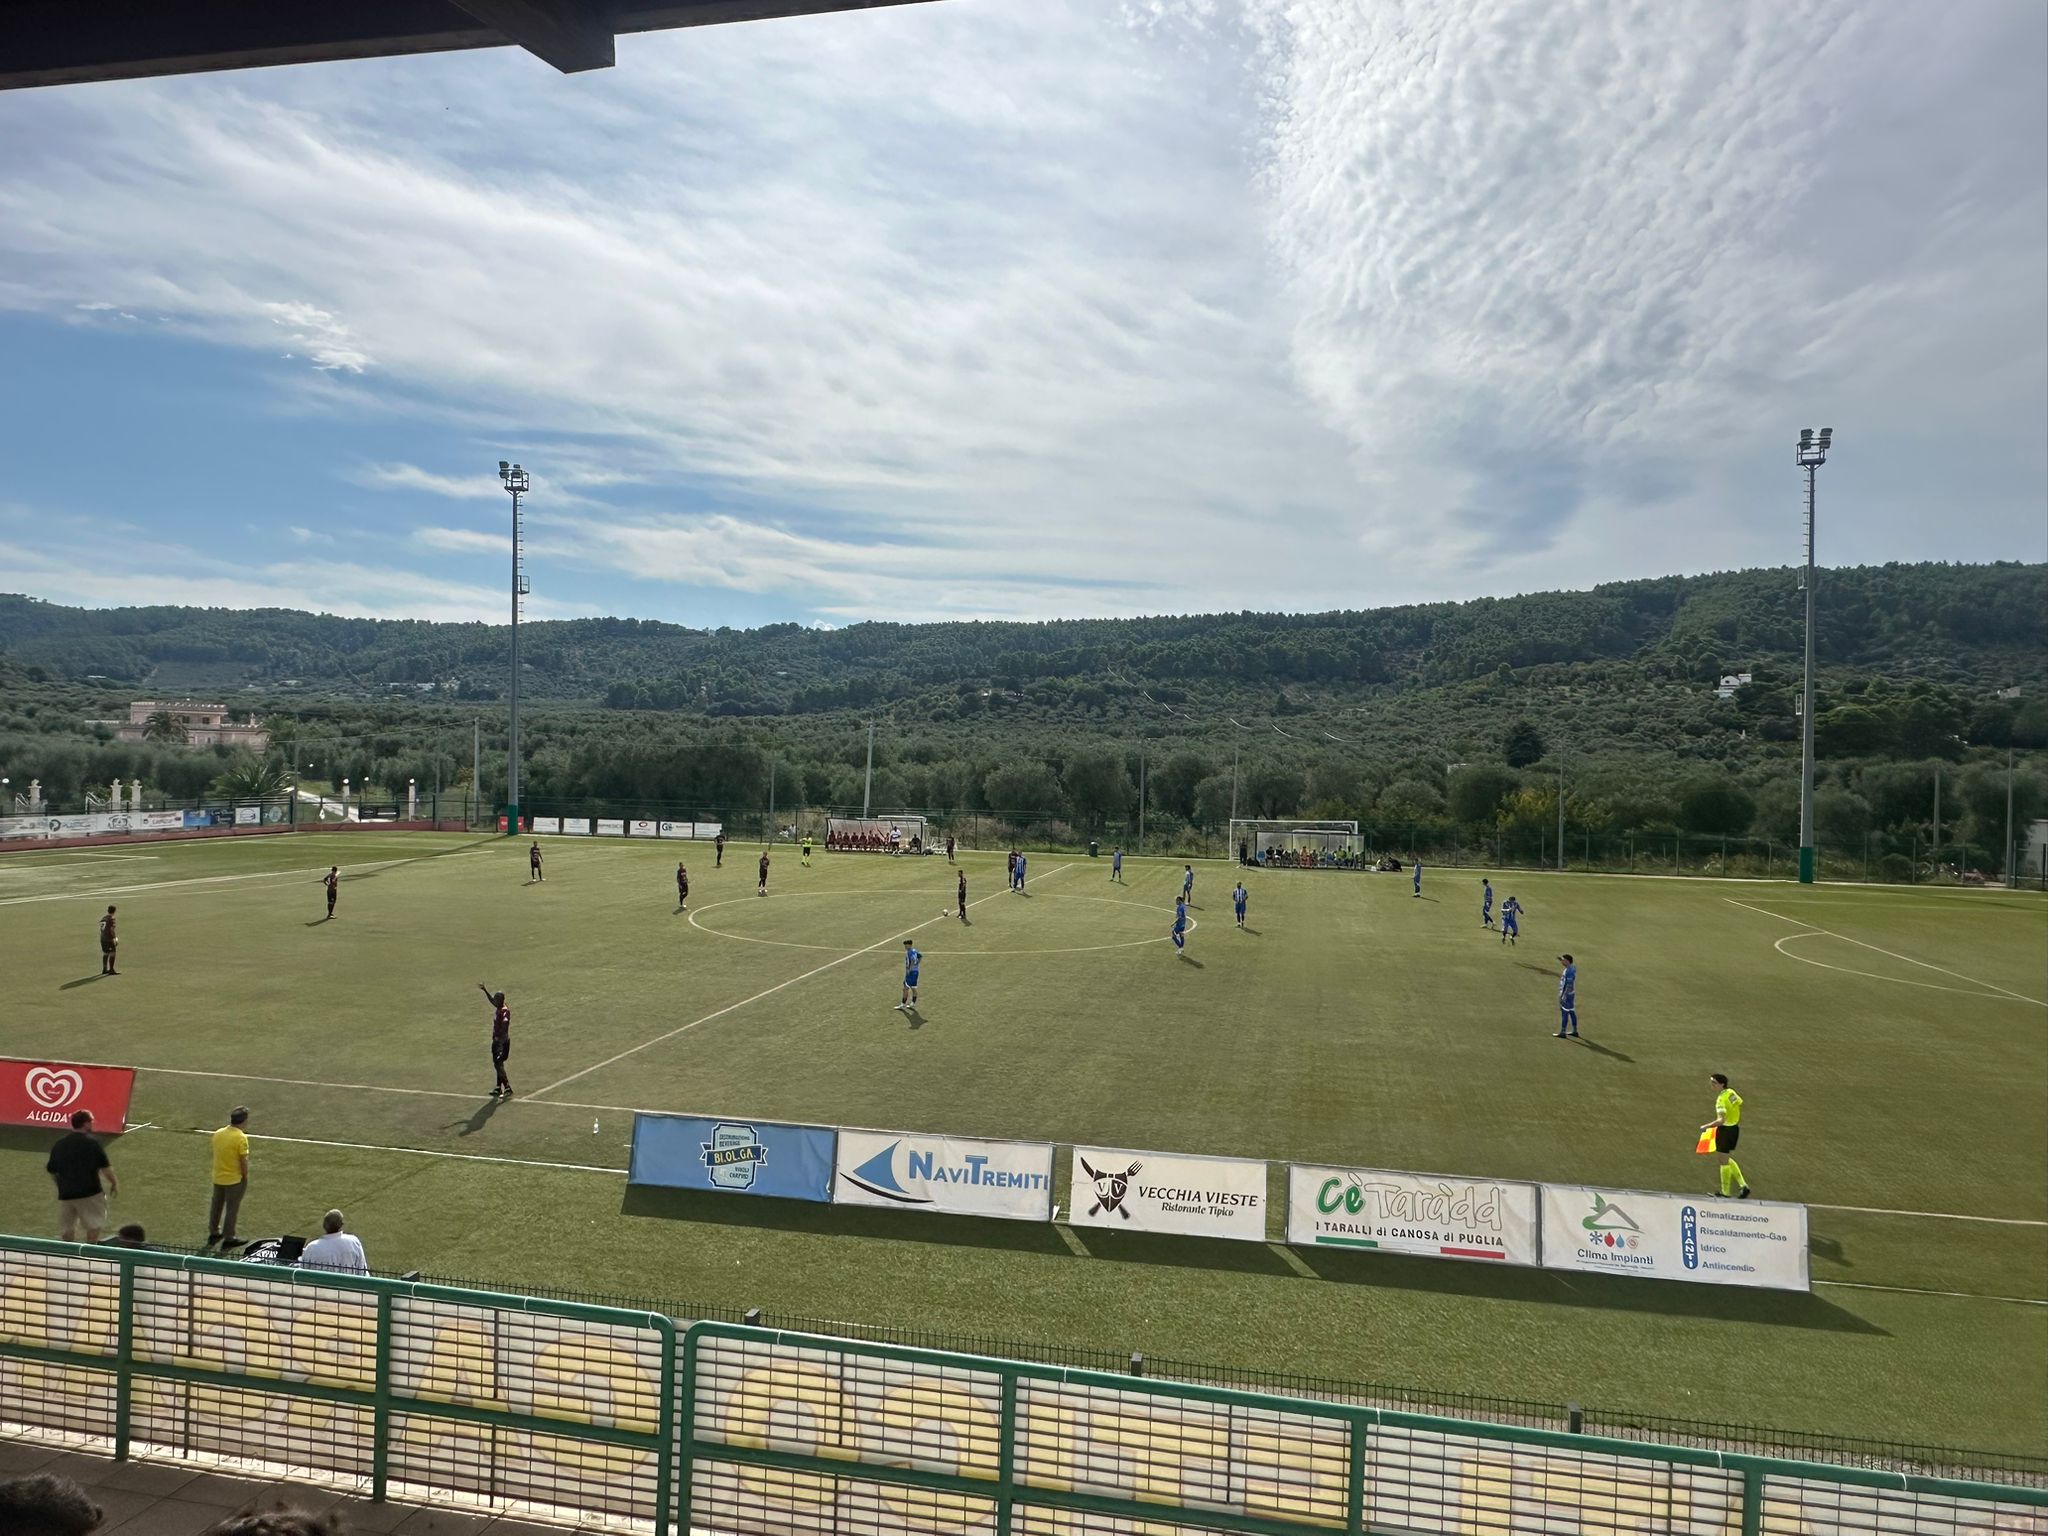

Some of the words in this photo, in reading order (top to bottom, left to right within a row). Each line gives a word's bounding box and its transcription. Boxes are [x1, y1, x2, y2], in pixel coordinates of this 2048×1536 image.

[26, 1111, 68, 1123] ALGIDA
[1138, 1186, 1201, 1203] VECCHIA
[1205, 1191, 1259, 1207] VIESTE
[1161, 1202, 1207, 1215] Ristorante
[1208, 1206, 1235, 1218] Tipico
[1699, 1210, 1770, 1224] Climatizzazione
[1324, 1222, 1373, 1236] TARALLI
[1376, 1226, 1387, 1237] di
[1391, 1228, 1439, 1242] CANOSA
[1443, 1232, 1455, 1242] di
[1459, 1233, 1504, 1247] PUGLIA
[1683, 1206, 1696, 1269] IMPIANTI
[1700, 1227, 1788, 1242] Riscaldamento-Gas
[1700, 1244, 1727, 1254] Idrico
[1577, 1248, 1609, 1262] Clima
[1610, 1251, 1654, 1266] Impianti
[1701, 1261, 1756, 1273] Antincendio
